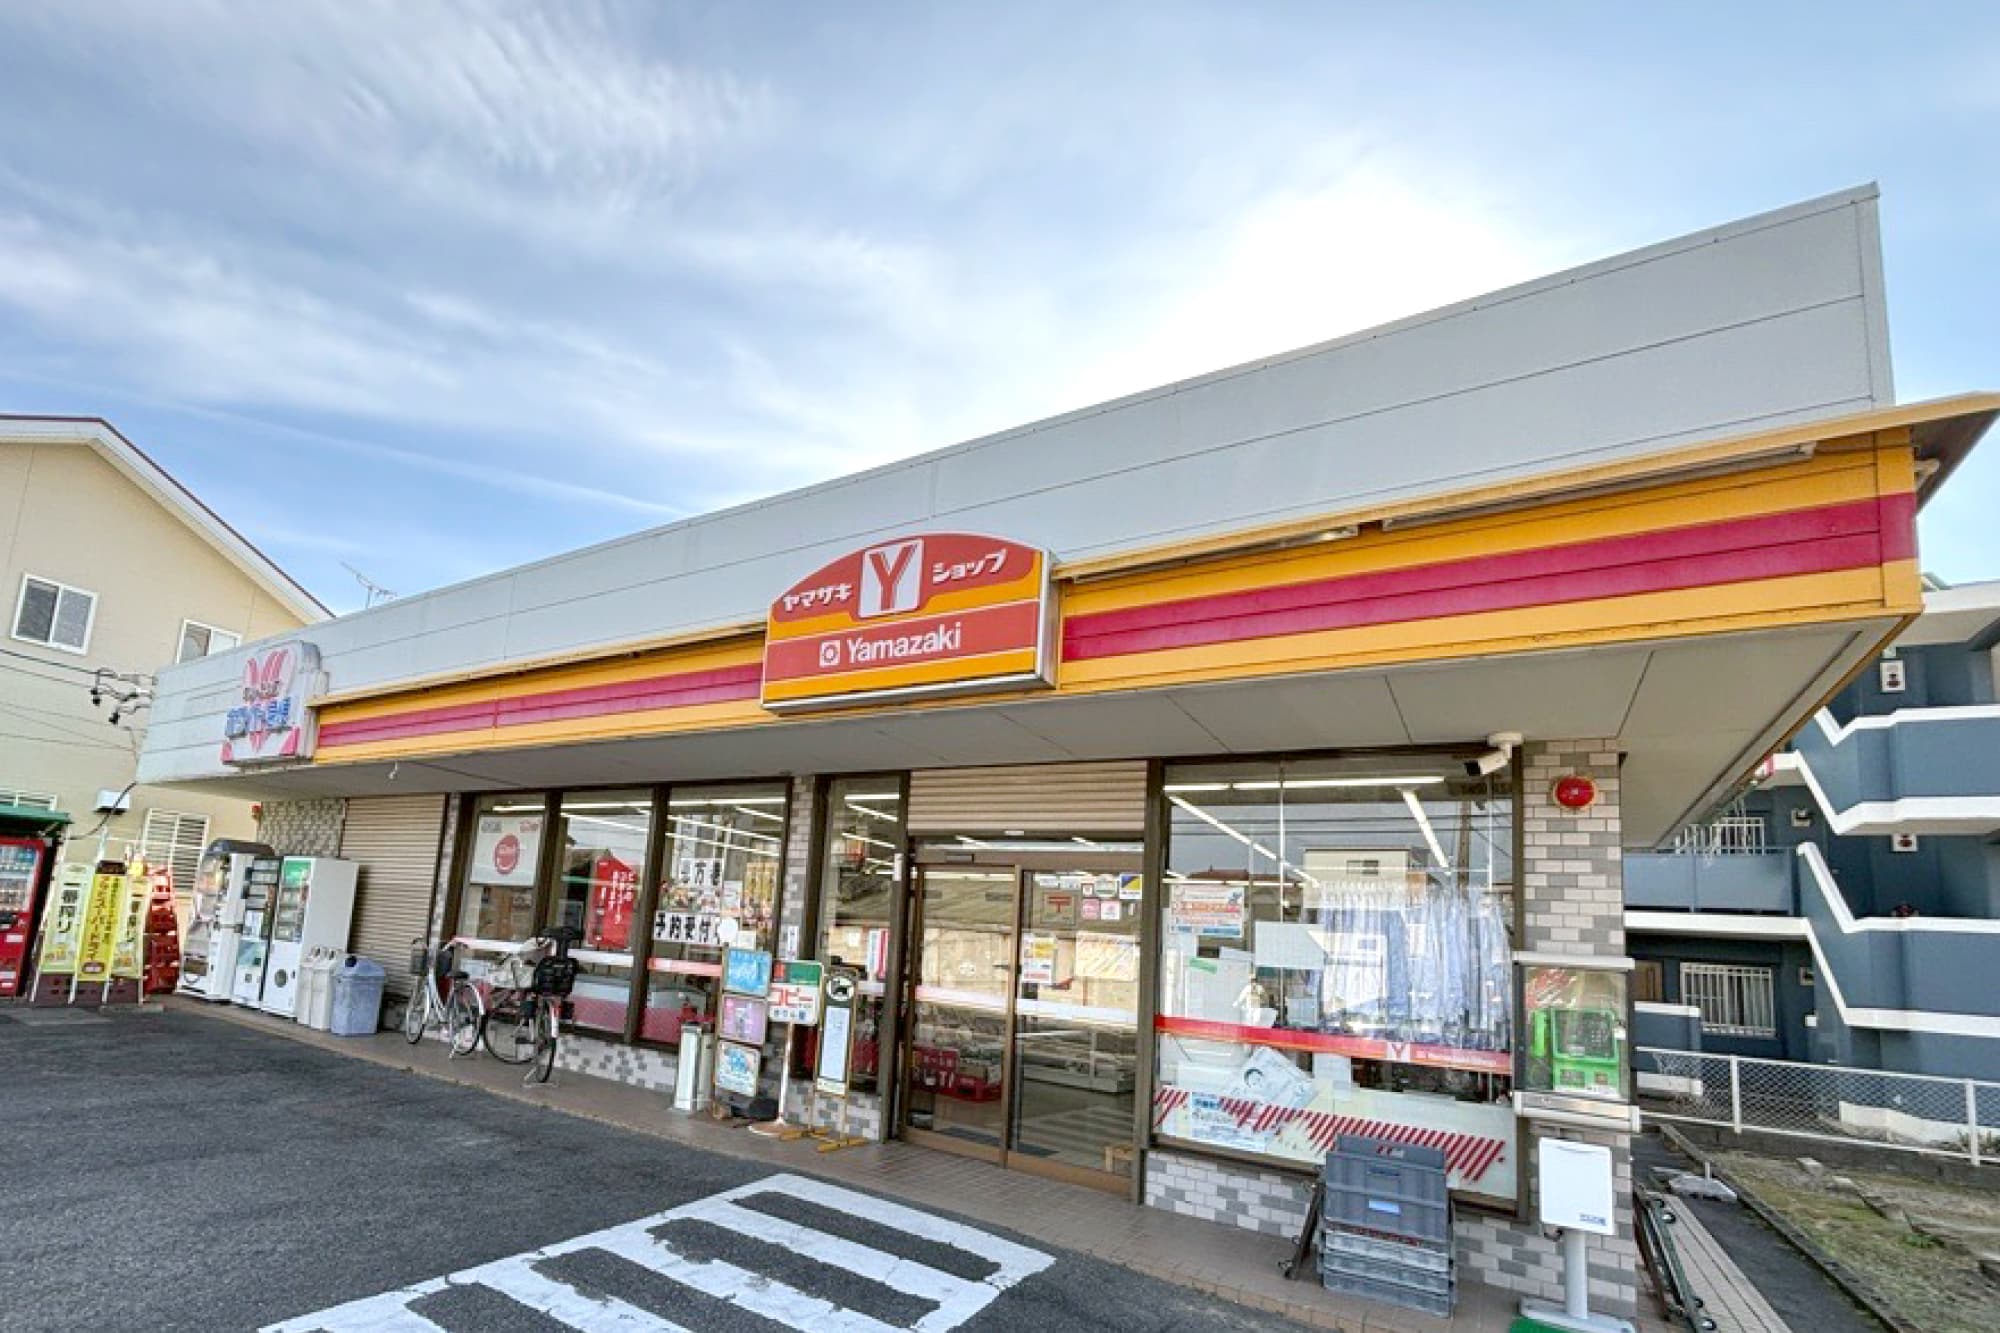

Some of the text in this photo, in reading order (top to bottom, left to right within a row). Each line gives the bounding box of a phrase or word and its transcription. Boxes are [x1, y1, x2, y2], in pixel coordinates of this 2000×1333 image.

[783, 543, 1006, 612] ヤマザキ Y ショップ
[847, 622, 962, 664] Yamazaki
